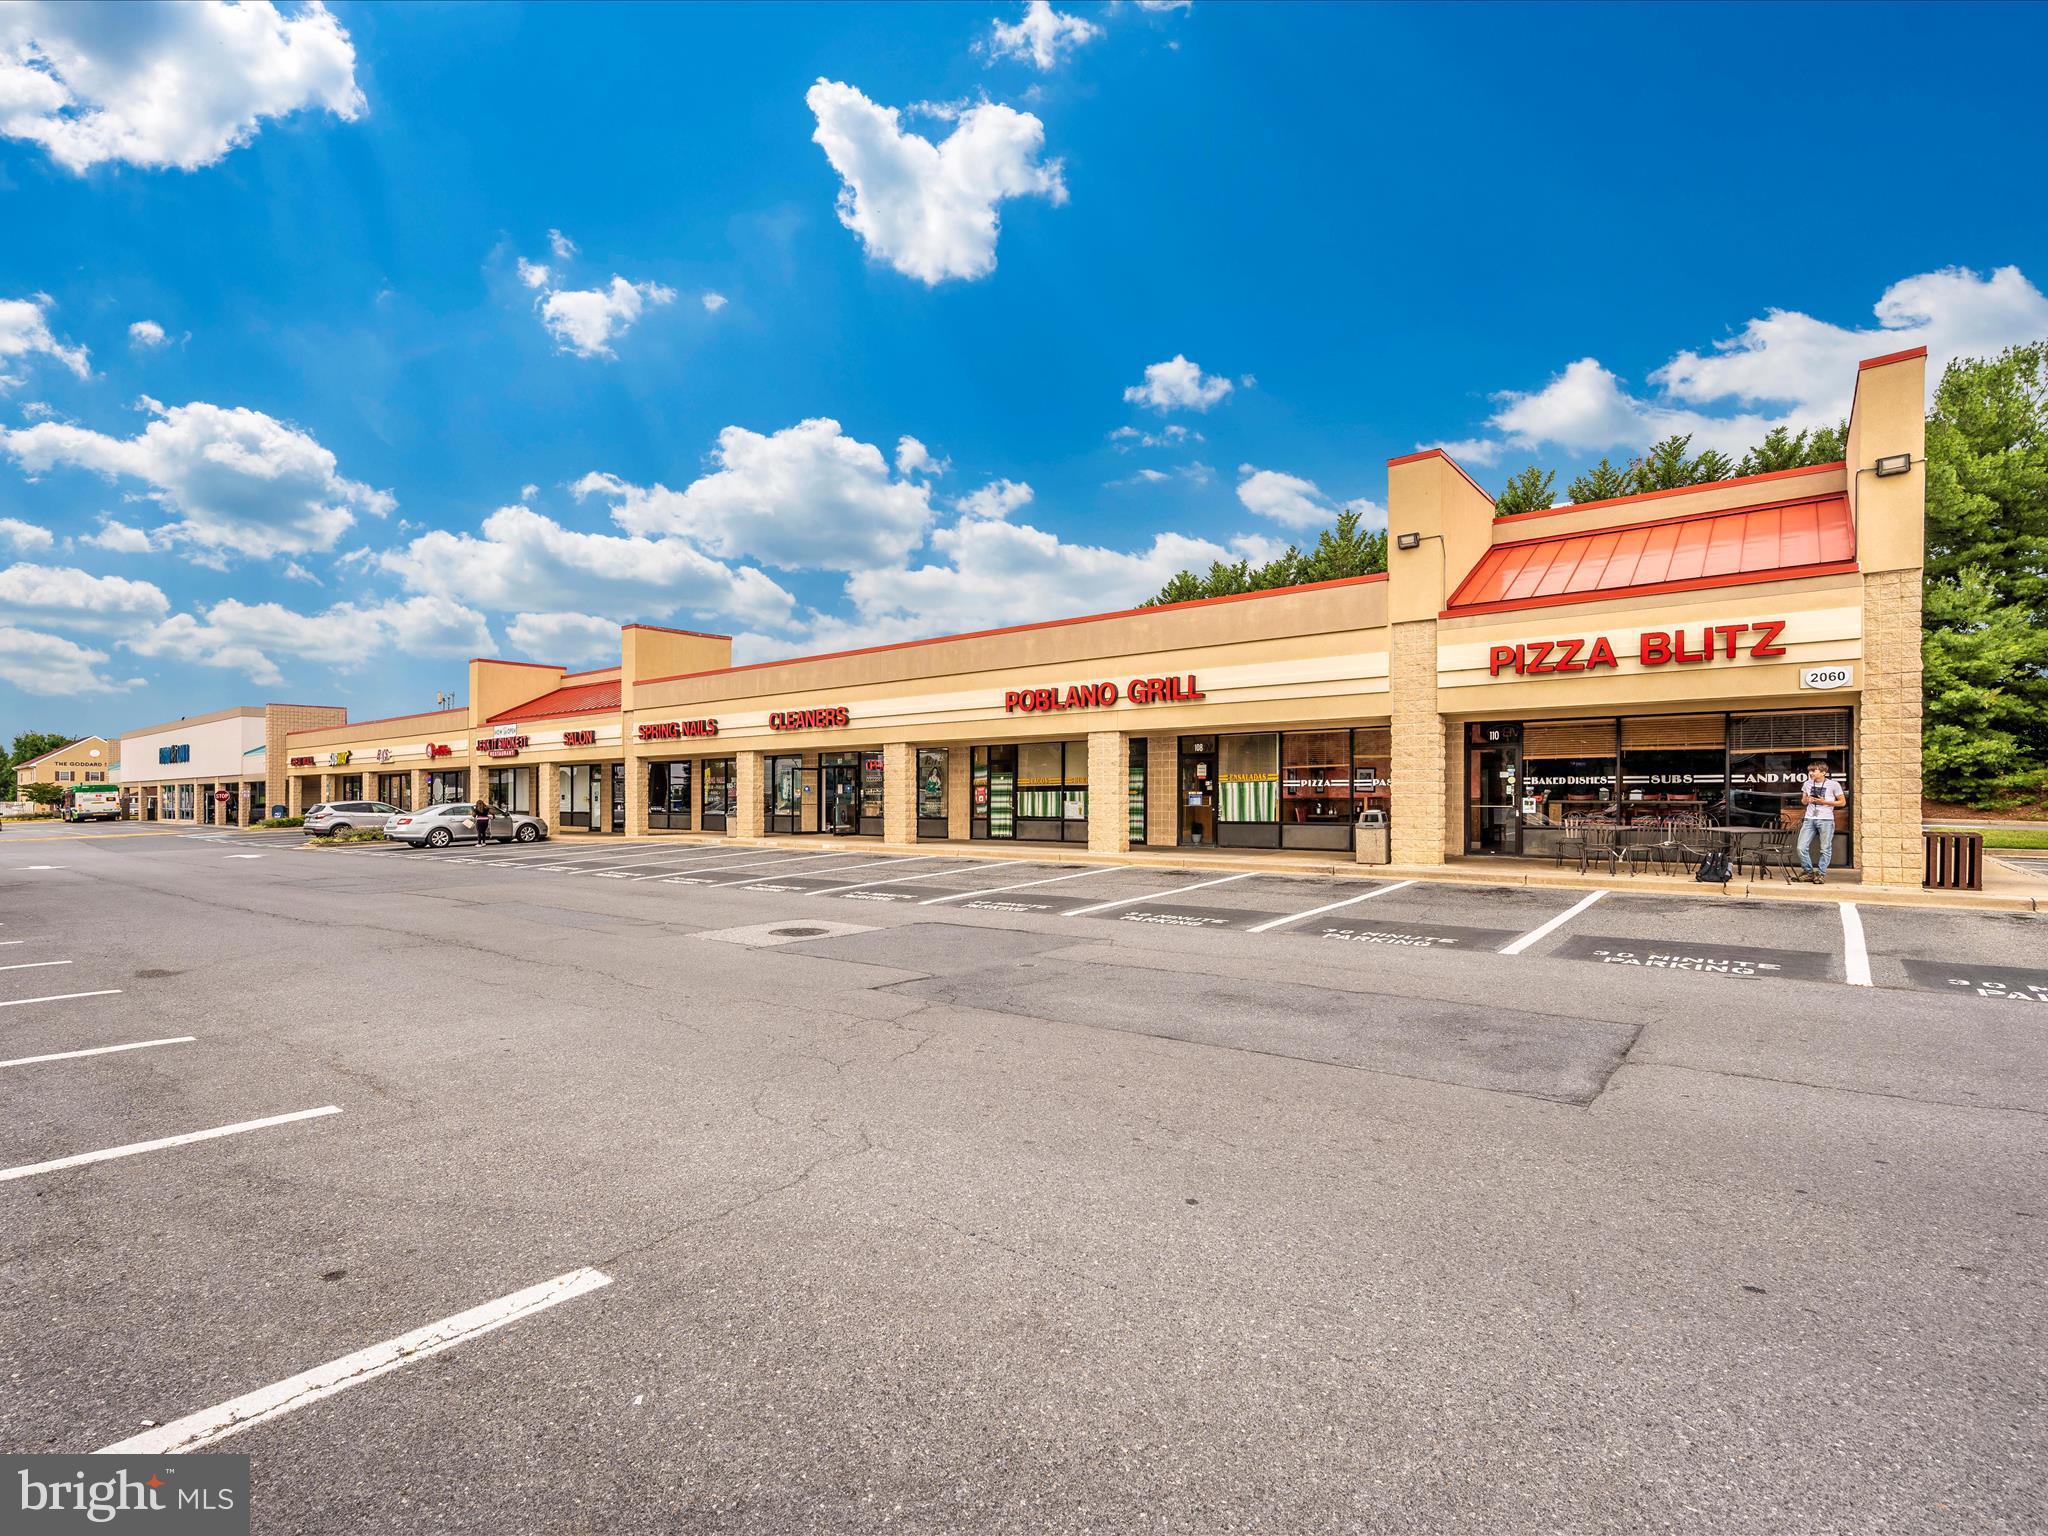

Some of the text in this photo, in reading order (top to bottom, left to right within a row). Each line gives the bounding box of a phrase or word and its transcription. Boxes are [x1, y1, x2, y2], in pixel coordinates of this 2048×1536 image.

[1490, 620, 1787, 677] PIZZA BLITZ
[1810, 670, 1846, 684] 2060
[1005, 675, 1206, 713] POBLANO GRILL
[768, 706, 849, 731] CLEANERS
[638, 719, 718, 741] SPRING NAILS
[1489, 730, 1500, 741] 110
[476, 739, 490, 751] JERK
[498, 736, 519, 750] SMOKE
[563, 730, 594, 746] SALON
[1194, 743, 1204, 752] 108
[1229, 773, 1267, 781] ENSALADAS
[1300, 779, 1331, 787] PIZZA
[1531, 775, 1608, 786] BAKED DISHES
[1651, 774, 1694, 785] SUBS
[1745, 773, 1779, 783] AND
[1120, 915, 1203, 927] PARKING
[1153, 913, 1229, 924] MINUTE
[1322, 933, 1431, 947] PARKING
[1362, 931, 1459, 944] MINUTE
[1593, 950, 1782, 971] 30 MINUTE
[1603, 956, 1755, 975] PARKING
[1947, 979, 2007, 989] 30
